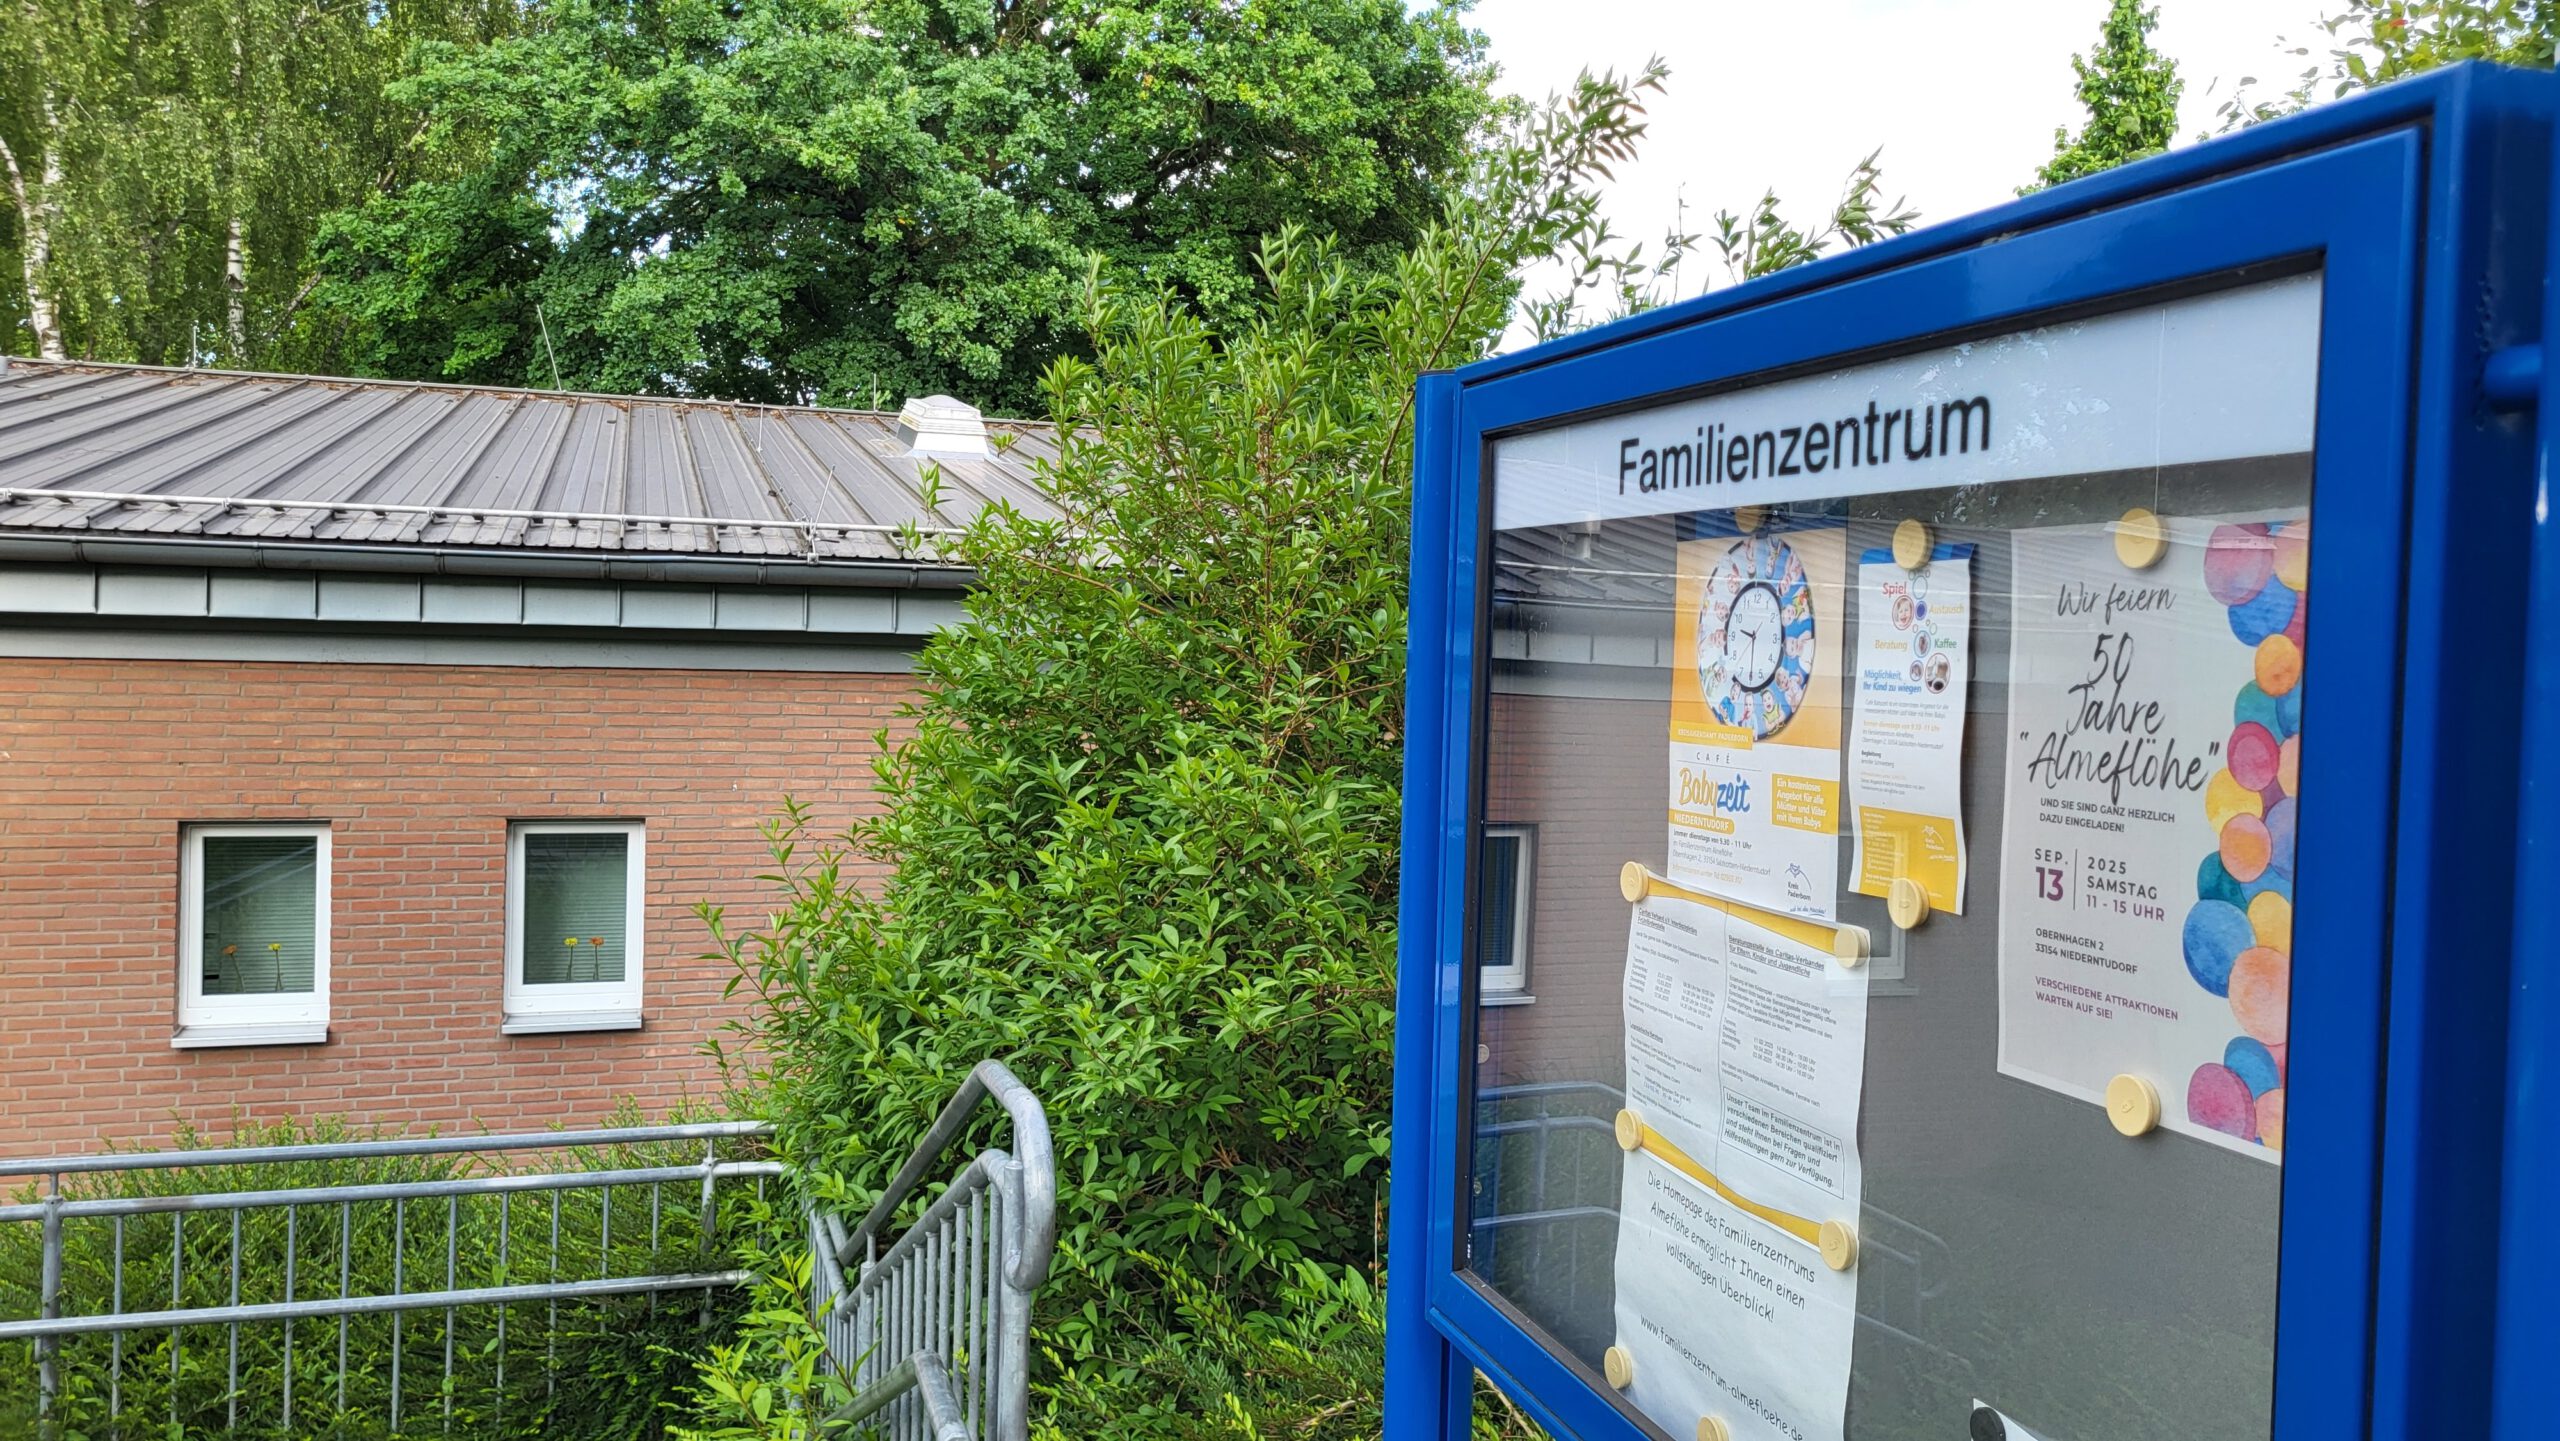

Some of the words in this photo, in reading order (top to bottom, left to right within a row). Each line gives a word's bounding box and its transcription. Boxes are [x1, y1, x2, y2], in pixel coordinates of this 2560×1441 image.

[1618, 395, 1991, 496] Familienzentrum
[1753, 593, 1761, 604] 12
[1882, 581, 1907, 598] Spiel
[1743, 600, 1750, 609] 11
[2058, 581, 2101, 616] Wir
[2105, 582, 2177, 626] feiern
[1735, 614, 1743, 623] 10
[1770, 612, 1776, 623] 2
[1772, 633, 1777, 644] 3
[1875, 640, 1908, 651] Beratung
[1934, 638, 1957, 649] Kaffee
[2087, 632, 2134, 685] 50
[1863, 681, 1872, 691] Ihr
[1873, 682, 1888, 691] Kind
[1888, 684, 1896, 692] zu
[1898, 683, 1922, 695] wiegen
[2066, 683, 2166, 736] Jahre
[1696, 752, 1730, 764] CAFÉ
[1679, 767, 1751, 816] Babyzeit
[1777, 778, 1787, 787] Ein
[1776, 790, 1802, 801] Angebot
[1803, 793, 1812, 802] für
[1813, 795, 1824, 805] alle
[1777, 800, 1797, 812] Mütter
[1798, 805, 1810, 814] und
[1811, 806, 1827, 816] Väter
[1674, 813, 1730, 831] NIEDERNTUDORF
[1776, 812, 1787, 822] mit
[1803, 816, 1821, 829] Babys
[2040, 797, 2059, 808] UND
[2061, 800, 2075, 810] SIE
[2076, 802, 2098, 813] SIND
[2100, 805, 2125, 817] GANZ
[2128, 808, 2175, 823] HERZLICH
[2040, 813, 2063, 824] DAZU
[2065, 816, 2125, 833] EINGELADEN!
[1742, 841, 1752, 850] Uhr
[2034, 848, 2069, 865] SEP.
[2088, 857, 2127, 875] 2025
[1788, 881, 1799, 891] Kreis
[1788, 890, 1812, 901] Paderborn
[2035, 866, 2064, 901] 13
[2087, 876, 2158, 900] SAMSTAG
[2086, 894, 2097, 909] 11
[2113, 899, 2127, 914] 15
[2133, 903, 2165, 922] UHR
[2036, 927, 2096, 950] OBERNHAGEN
[2098, 941, 2104, 951] 2
[1752, 953, 1767, 963] Kinder
[1768, 957, 1777, 966] und
[1778, 961, 1811, 977] Jugendliche
[1766, 946, 1774, 955] des
[1775, 949, 1825, 970] Caritas-Verbandes
[2035, 943, 2058, 957] 33154
[2060, 949, 2138, 975] NIEDERNTUDORF
[2035, 975, 2103, 1001] VERSCHIEDENE
[2105, 994, 2178, 1021] ATTRAKTIONEN
[2035, 991, 2073, 1009] WARTEN
[2075, 1002, 2094, 1015] AUF
[2096, 1007, 2113, 1020] SIE!
[1726, 1092, 1743, 1108] Unser
[1744, 1101, 1761, 1116] Team
[1762, 1108, 1770, 1118] im
[1770, 1112, 1823, 1143] Familienzentrum
[1824, 1136, 1833, 1147] ist
[1834, 1140, 1840, 1150] in
[1726, 1106, 1769, 1131] verschiedenen
[1770, 1124, 1801, 1146] Bereichen
[1803, 1139, 1838, 1163] qualifiziert
[1726, 1117, 1737, 1129] und
[1738, 1122, 1753, 1136] steht
[1773, 1136, 1783, 1148] bei
[1783, 1141, 1806, 1160] Fragen
[1807, 1155, 1821, 1167] und
[1724, 1128, 1773, 1155] Hilfestellungen
[1770, 1151, 1784, 1165] gern
[1786, 1159, 1797, 1170] zur
[1798, 1163, 1834, 1188] Verfügung.
[1647, 1169, 1661, 1190] Die
[1663, 1182, 1703, 1219] Homepage
[1704, 1210, 1718, 1230] des
[1719, 1217, 1815, 1284] Familienzentrums
[1650, 1201, 1690, 1239] Almeflöhe
[1691, 1230, 1737, 1271] ermöglicht
[1739, 1259, 1773, 1292] Ihnen
[1776, 1281, 1806, 1310] einen
[1666, 1242, 1718, 1289] vollständigen
[1719, 1275, 1775, 1323] Überblick!
[1640, 1313, 1804, 1441] www.familienzentrum-almefloehe.de
